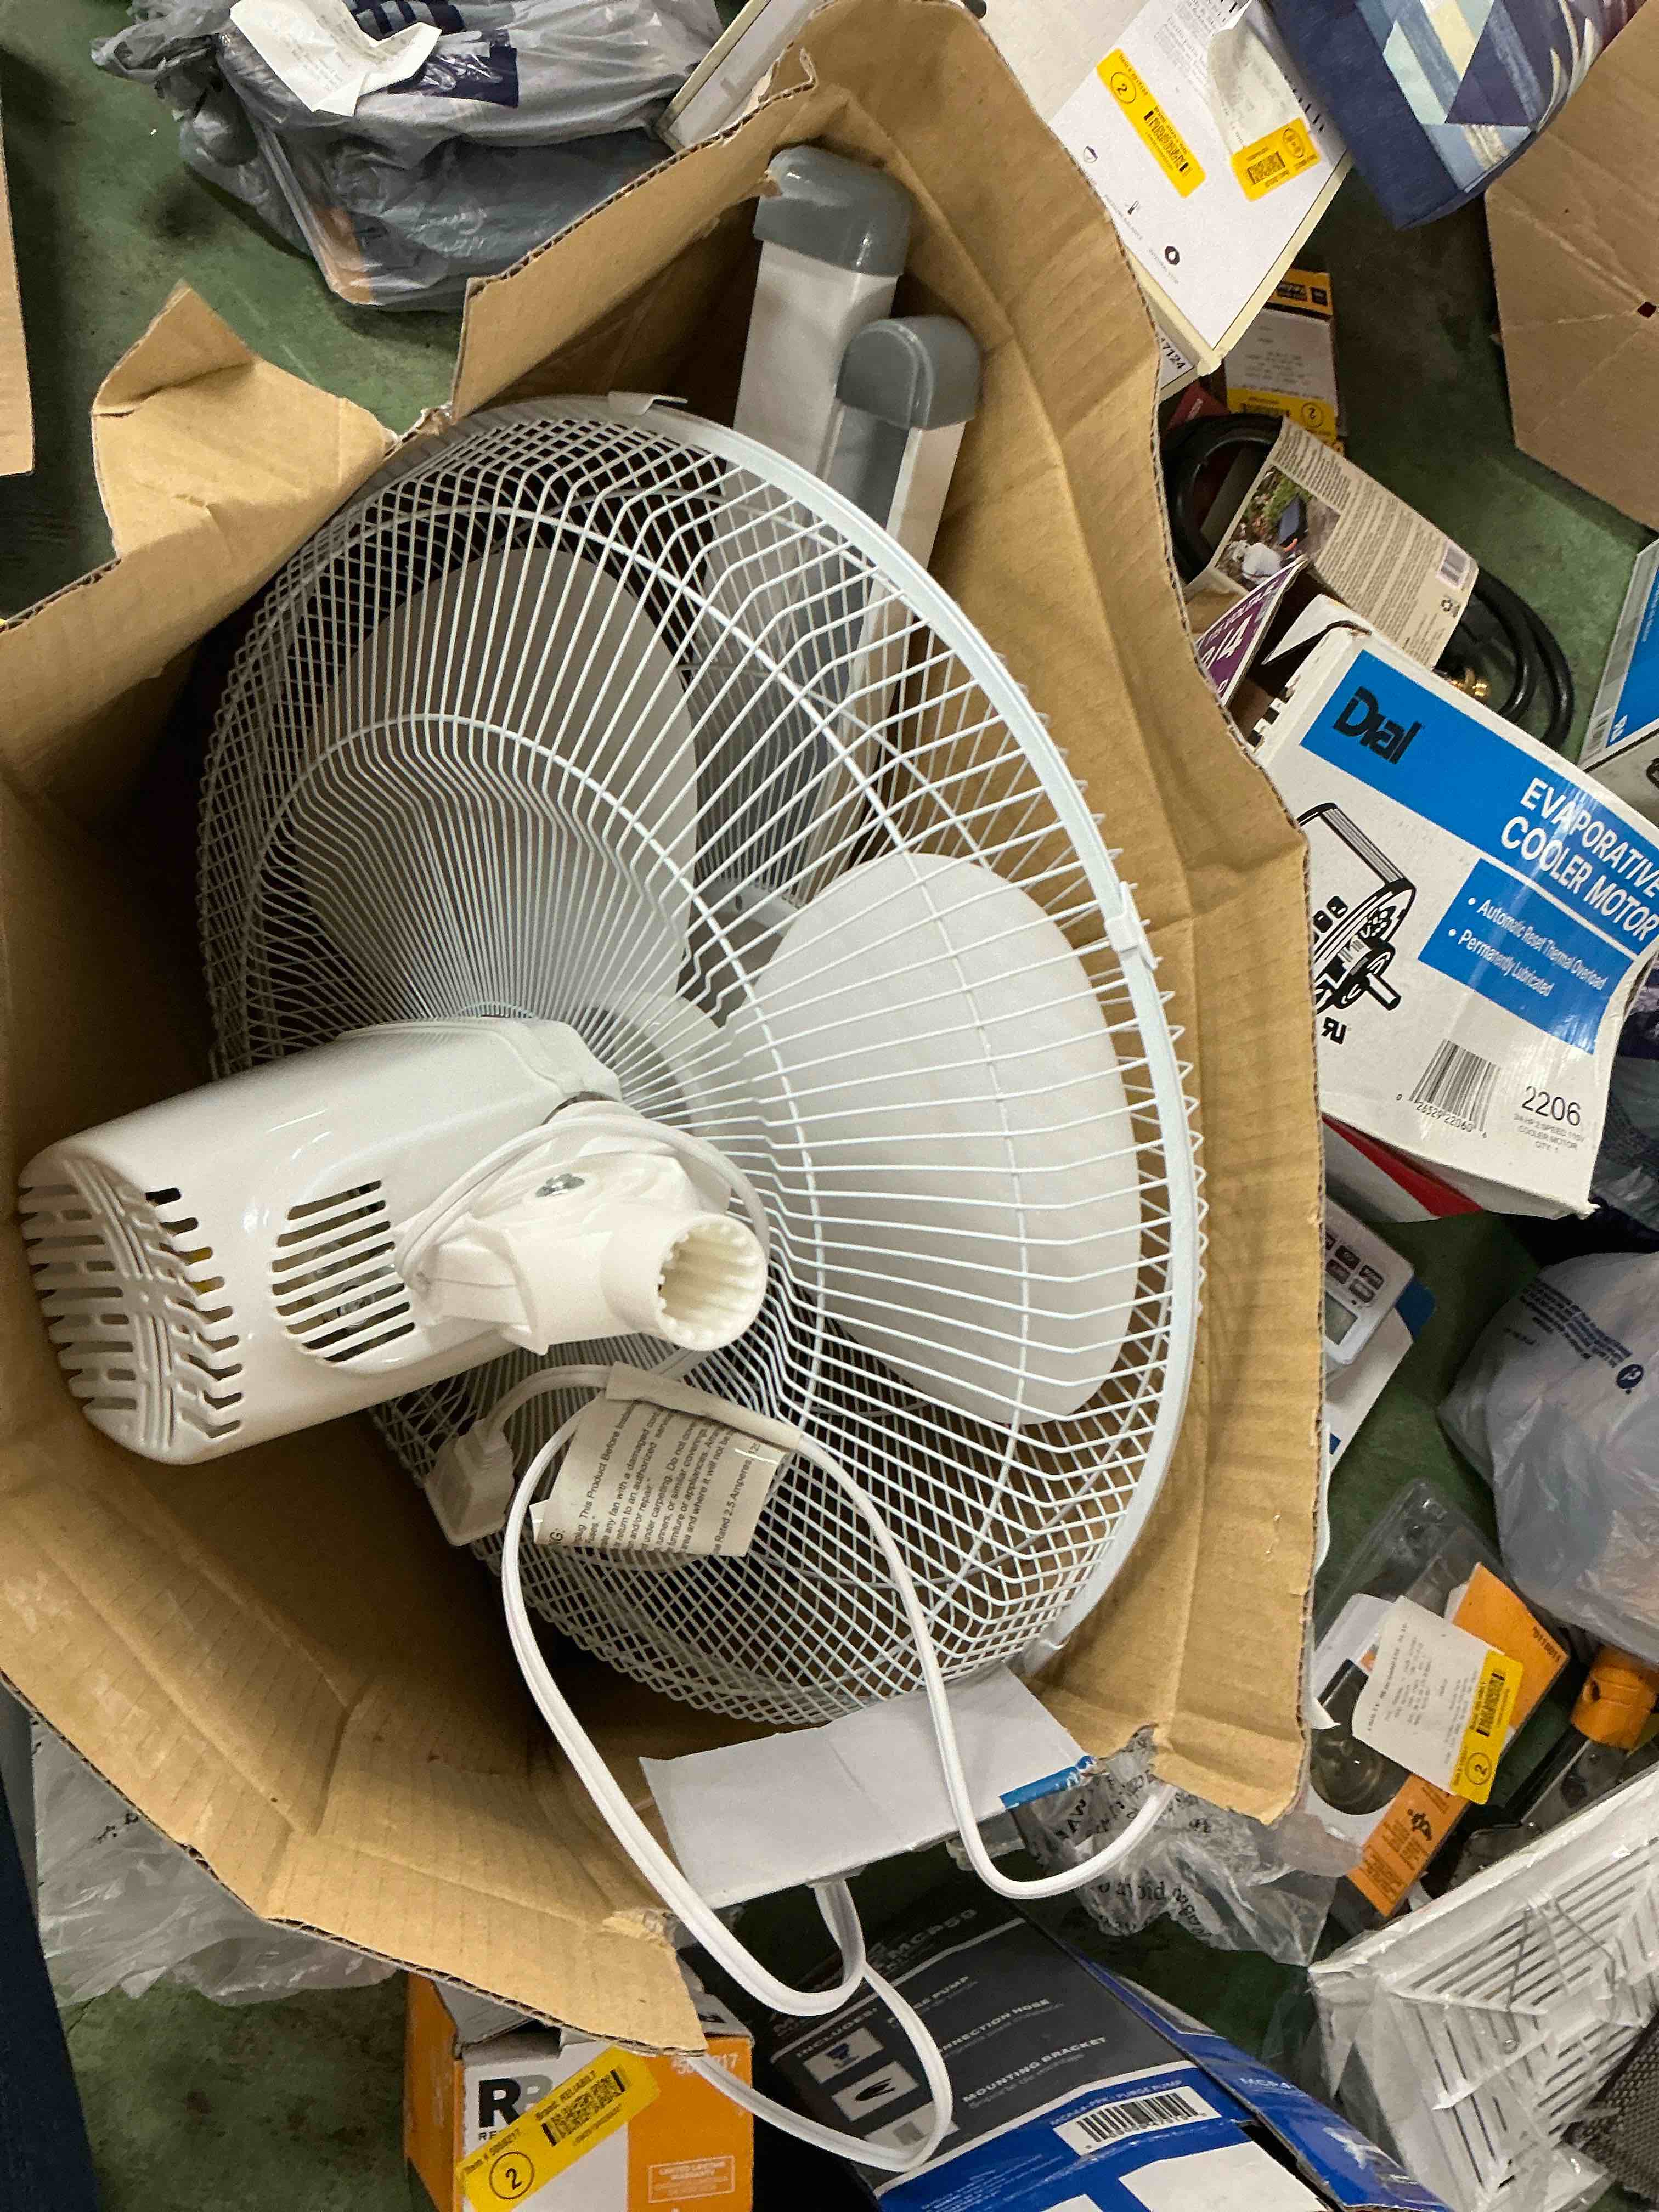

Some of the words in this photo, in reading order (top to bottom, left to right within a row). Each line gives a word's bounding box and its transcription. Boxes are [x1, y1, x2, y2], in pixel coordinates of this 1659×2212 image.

[1115, 82, 1129, 96] 2
[1308, 407, 1316, 419] 2
[1332, 684, 1423, 768] Dial
[1517, 776, 1659, 903] EVAPORATIVE
[1494, 812, 1596, 896] COOLER
[1581, 873, 1659, 944] MOTOR
[1476, 896, 1528, 939] Automatic
[1520, 924, 1549, 952] Reset
[1541, 938, 1577, 972] Thermal
[1568, 958, 1610, 992] Overload
[1455, 927, 1517, 977] Permanently
[1510, 960, 1556, 998] Lubricated
[1519, 1084, 1587, 1128] 2206
[601, 1429, 620, 1462] Before
[625, 1427, 651, 1471] damaged
[712, 1444, 725, 1460] not
[586, 1461, 607, 1499] Product
[631, 1441, 658, 1491] authorized
[704, 1460, 718, 1477] will
[614, 1480, 629, 1500] with
[627, 1491, 638, 1504] an
[641, 1519, 657, 1543] under
[665, 1455, 679, 1471] Do
[673, 1440, 686, 1457] not
[669, 1468, 688, 1500] similar
[579, 1499, 594, 1520] This
[608, 1500, 621, 1516] fan
[623, 1505, 633, 1515] to
[667, 1500, 676, 1511] or
[691, 1485, 709, 1515] where
[714, 1516, 731, 1543] Rated
[724, 1500, 736, 1516] 2.5
[730, 1455, 755, 1502] Amperes,
[603, 1516, 617, 1534] any
[614, 1515, 630, 1541] return
[628, 1512, 645, 1540] and/or
[667, 1513, 686, 1547] furniture
[679, 1501, 689, 1512] or
[685, 1515, 698, 1533] and
[1472, 1762, 1489, 1776] 2
[930, 1974, 970, 2000] PUMP
[937, 2011, 1012, 2053] NNECTION
[1011, 1995, 1049, 2018] HOSE
[962, 2059, 1041, 2103] MOUNTING
[1040, 2034, 1107, 2065] BRACKET
[504, 2168, 523, 2191] 2
